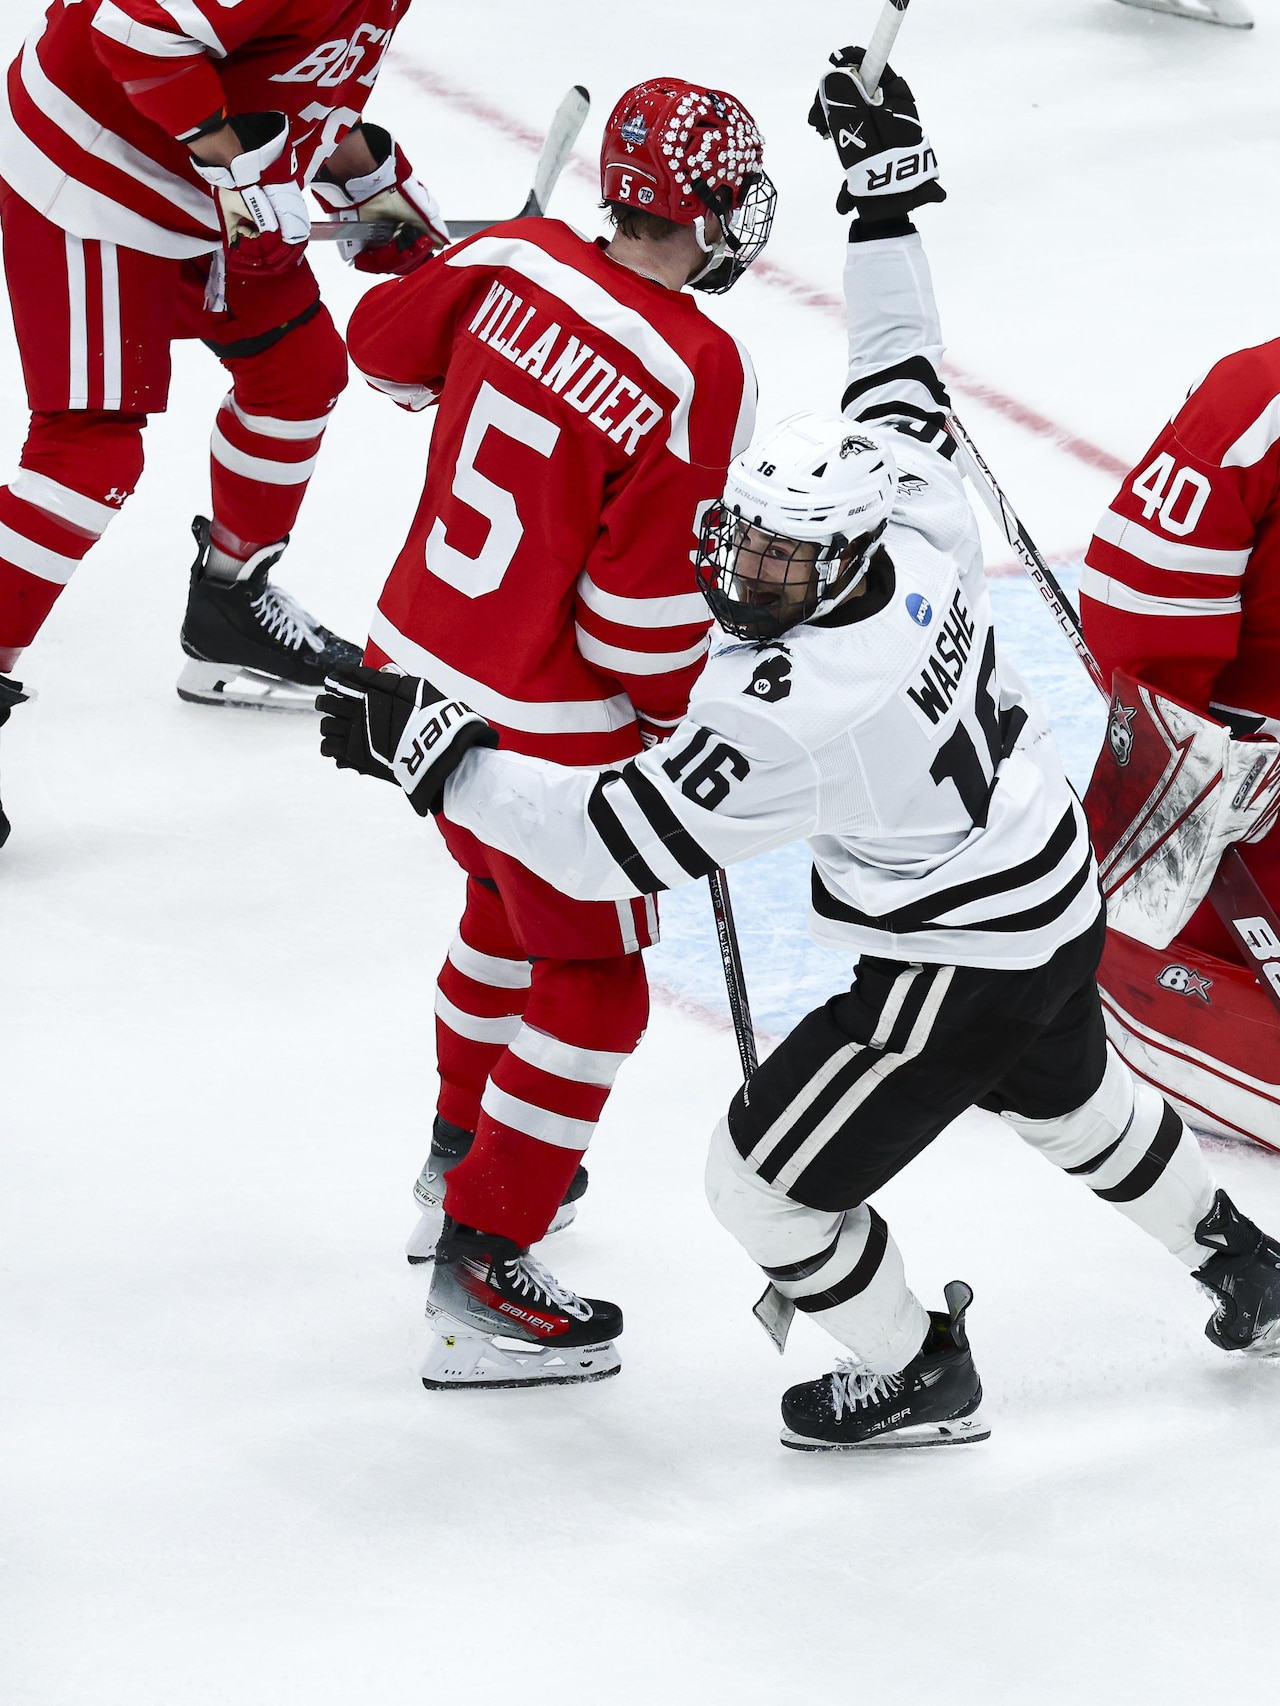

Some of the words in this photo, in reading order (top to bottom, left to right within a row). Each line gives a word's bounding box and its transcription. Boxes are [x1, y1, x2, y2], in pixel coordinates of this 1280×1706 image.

[619, 175, 633, 198] 5
[467, 280, 664, 457] WILLANDER
[425, 380, 561, 600] 5
[757, 461, 776, 477] 16
[1131, 451, 1211, 537] 40
[906, 588, 975, 725] WASHE
[400, 701, 473, 776] UER
[662, 727, 750, 810] 16
[929, 625, 1029, 829] 16
